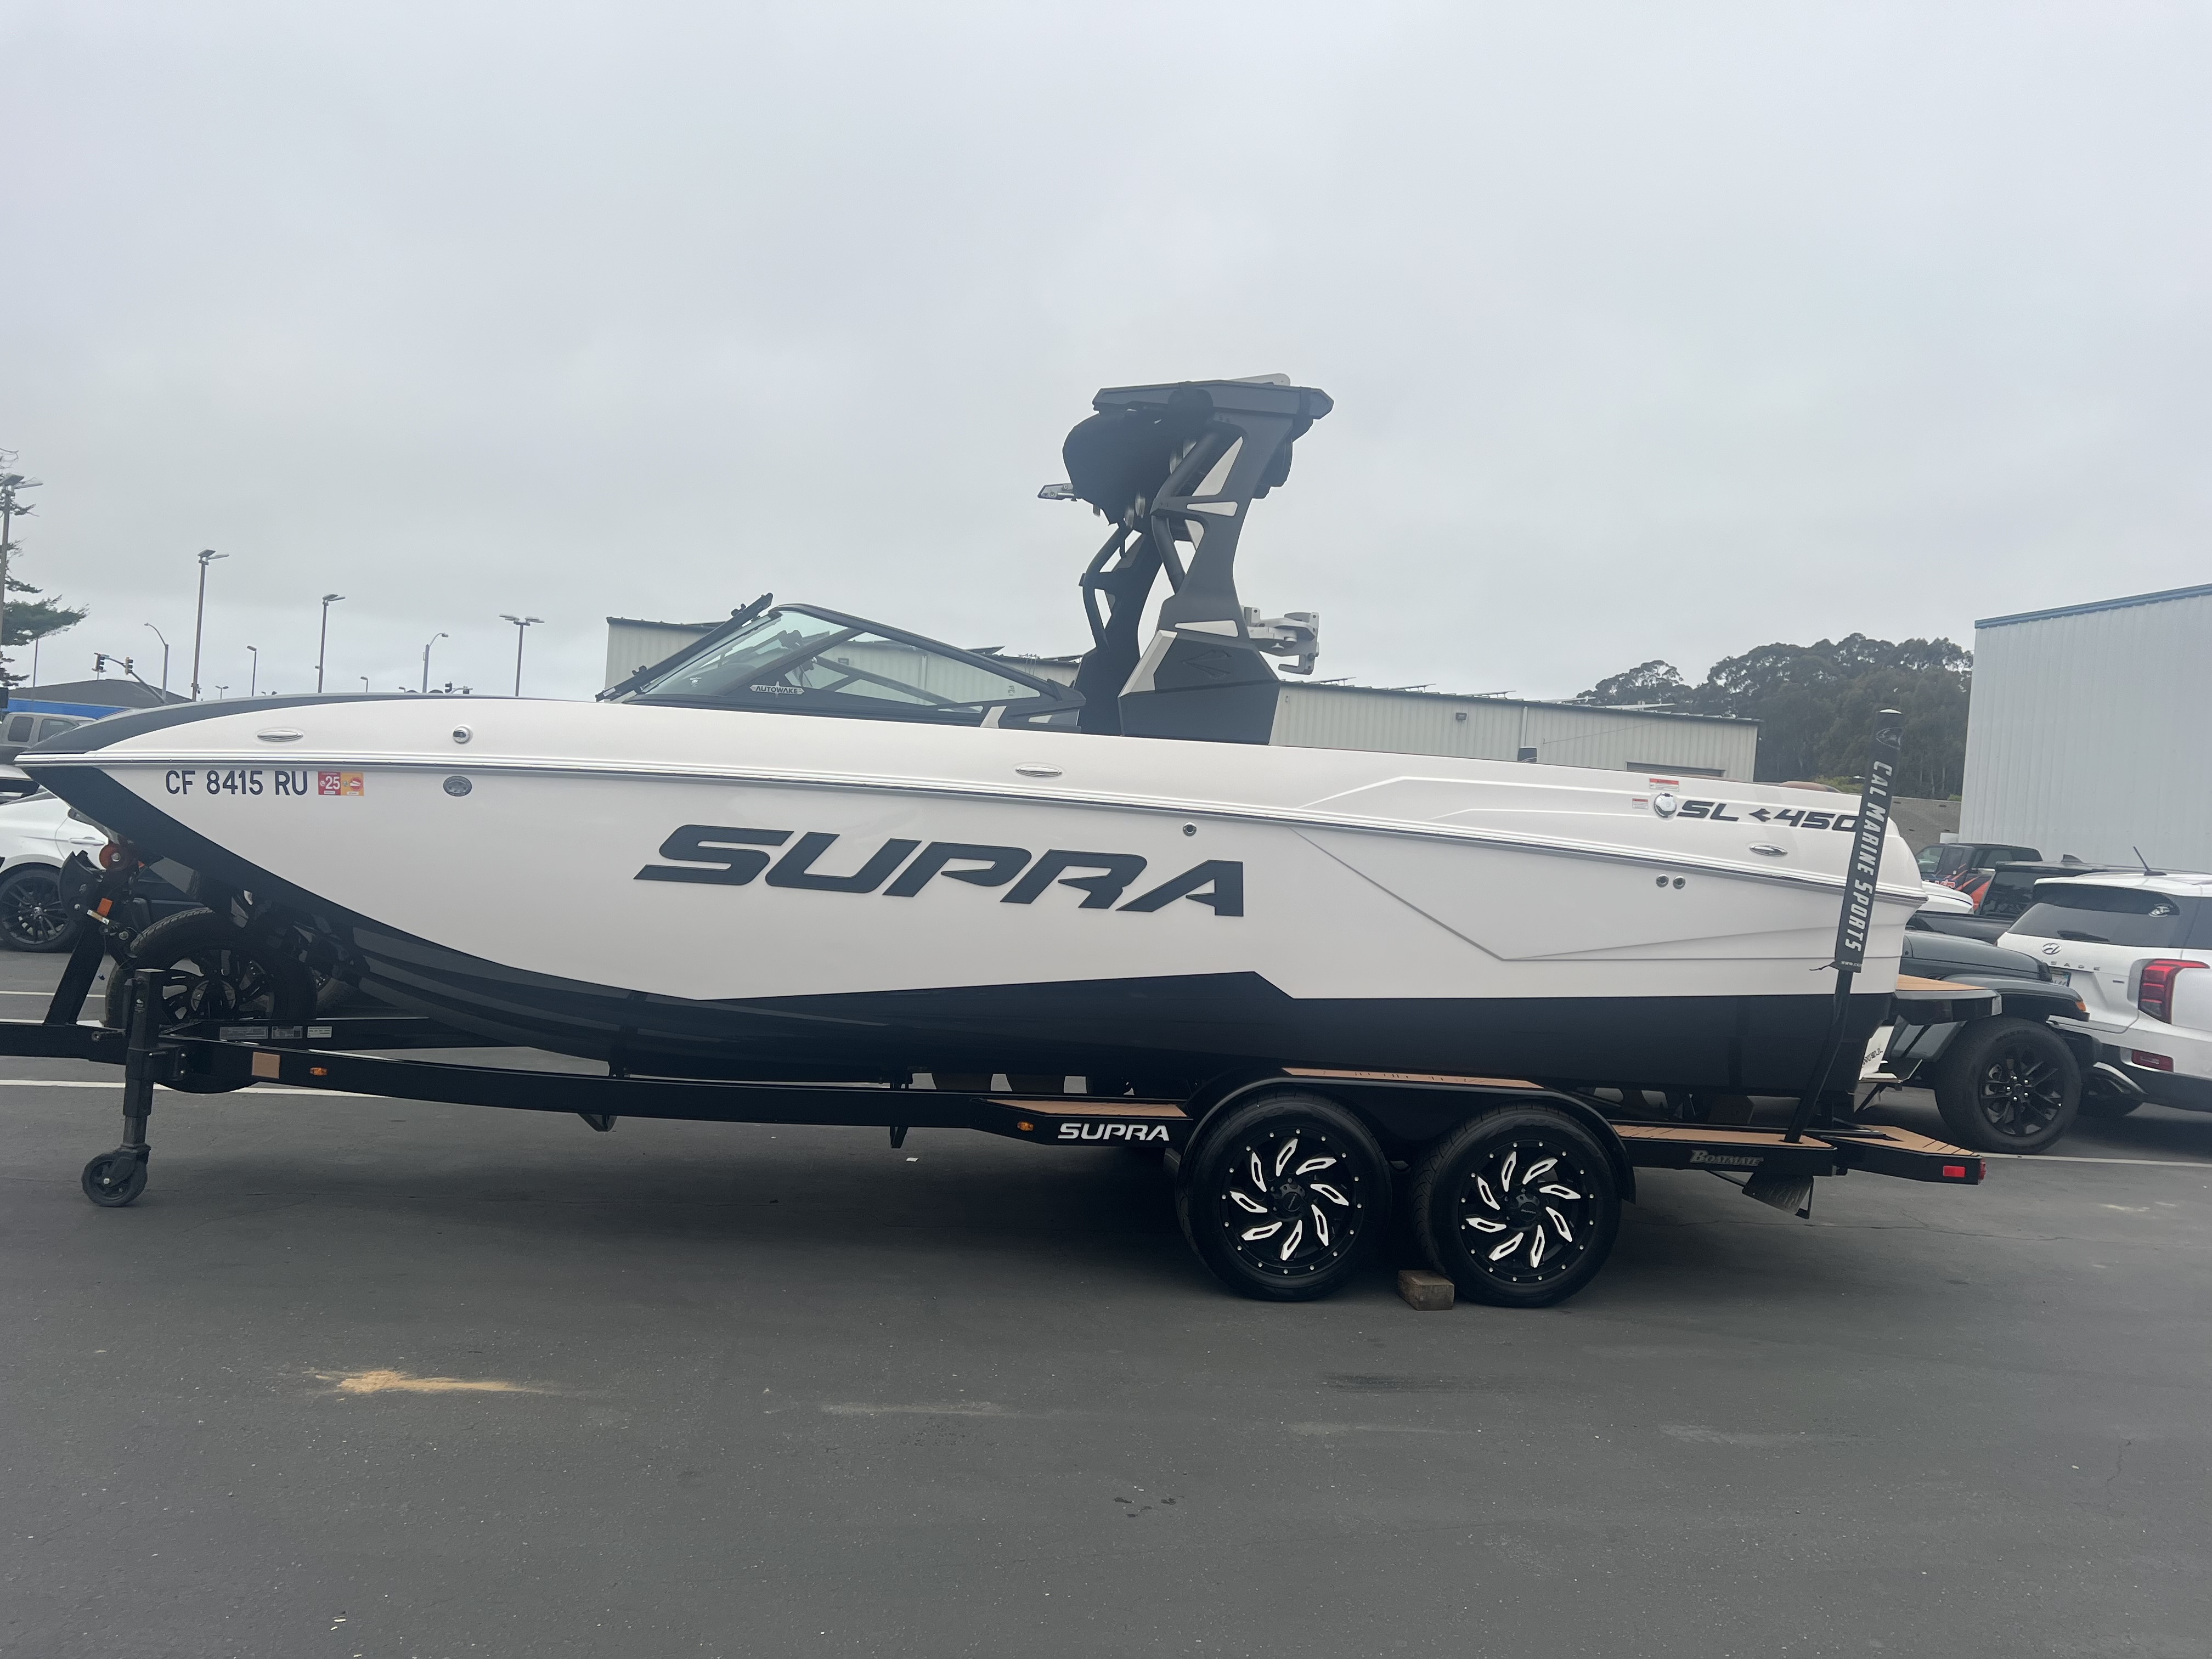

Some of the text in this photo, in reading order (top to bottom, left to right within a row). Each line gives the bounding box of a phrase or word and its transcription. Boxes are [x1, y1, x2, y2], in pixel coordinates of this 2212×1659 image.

[166, 770, 308, 796] CF 8415 RU
[325, 776, 340, 790] 25
[1677, 800, 1859, 832] SL 450
[633, 824, 1244, 917] SUPRA
[1844, 760, 1893, 952] CAL MARINE SPORTS
[1057, 1122, 1170, 1141] SUPRA
